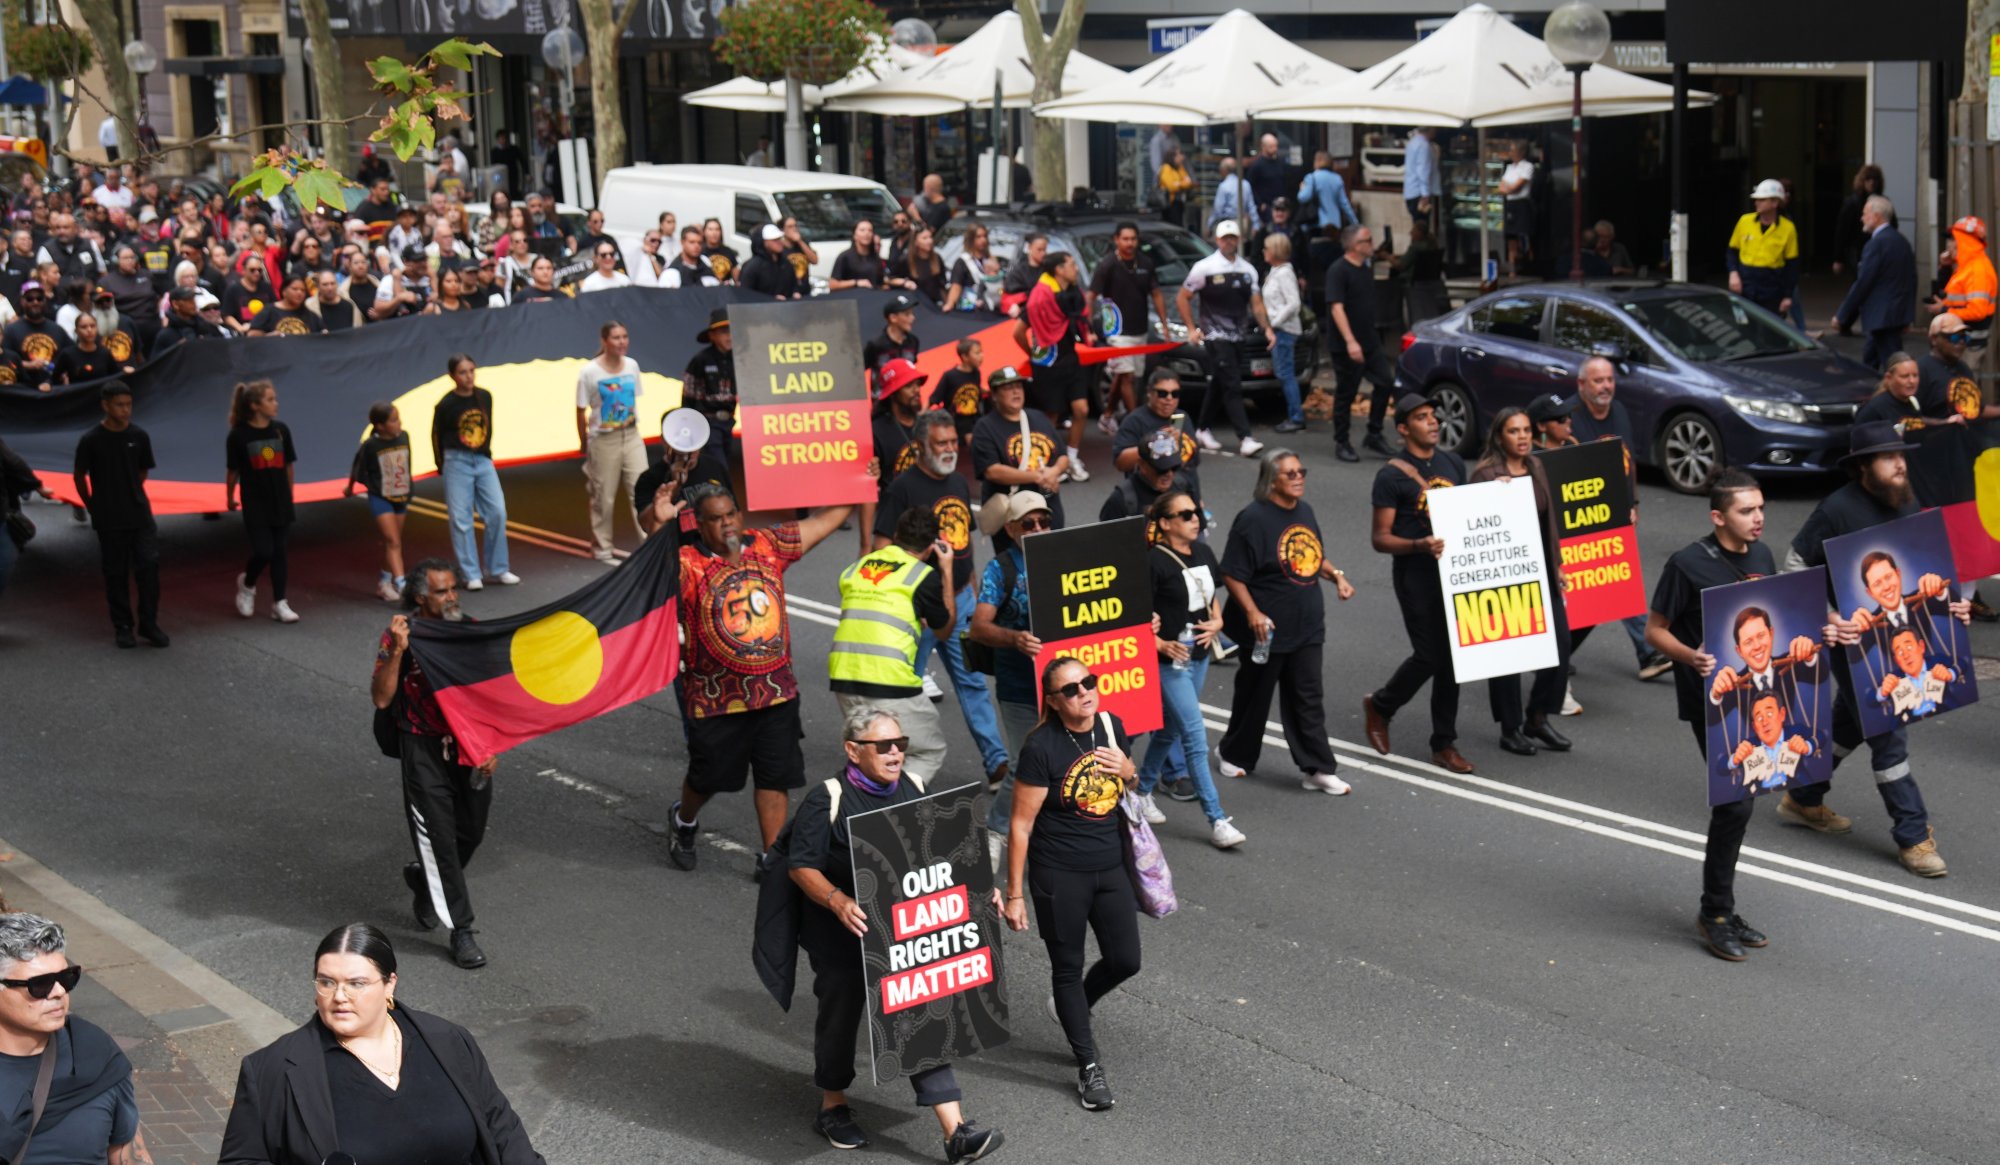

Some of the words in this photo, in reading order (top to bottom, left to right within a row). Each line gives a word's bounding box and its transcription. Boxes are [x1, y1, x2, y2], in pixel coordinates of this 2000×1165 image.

[768, 341, 828, 364] KEEP
[770, 371, 834, 394] LAND
[762, 410, 851, 435] RIGHTS
[760, 440, 858, 466] STRONG
[1561, 477, 1605, 502] KEEP
[1467, 515, 1502, 531] LAND
[1564, 503, 1611, 529] LAND
[1463, 531, 1512, 549] RIGHTS
[1560, 536, 1625, 566] RIGHTS
[1451, 550, 1477, 568] FOR
[1480, 545, 1530, 564] FUTURE
[1061, 565, 1118, 596] KEEP
[1449, 561, 1540, 586] GENERATIONS
[1566, 561, 1631, 593] STRONG
[1062, 597, 1123, 628] LAND
[1454, 582, 1545, 646] NOW!
[1097, 667, 1146, 696] ONG
[1746, 754, 1765, 771] Rule
[1780, 752, 1797, 765] Law
[902, 861, 954, 898] OUR
[898, 894, 964, 935] LAND
[889, 922, 980, 972] RIGHTS
[887, 953, 989, 1007] MATTER
